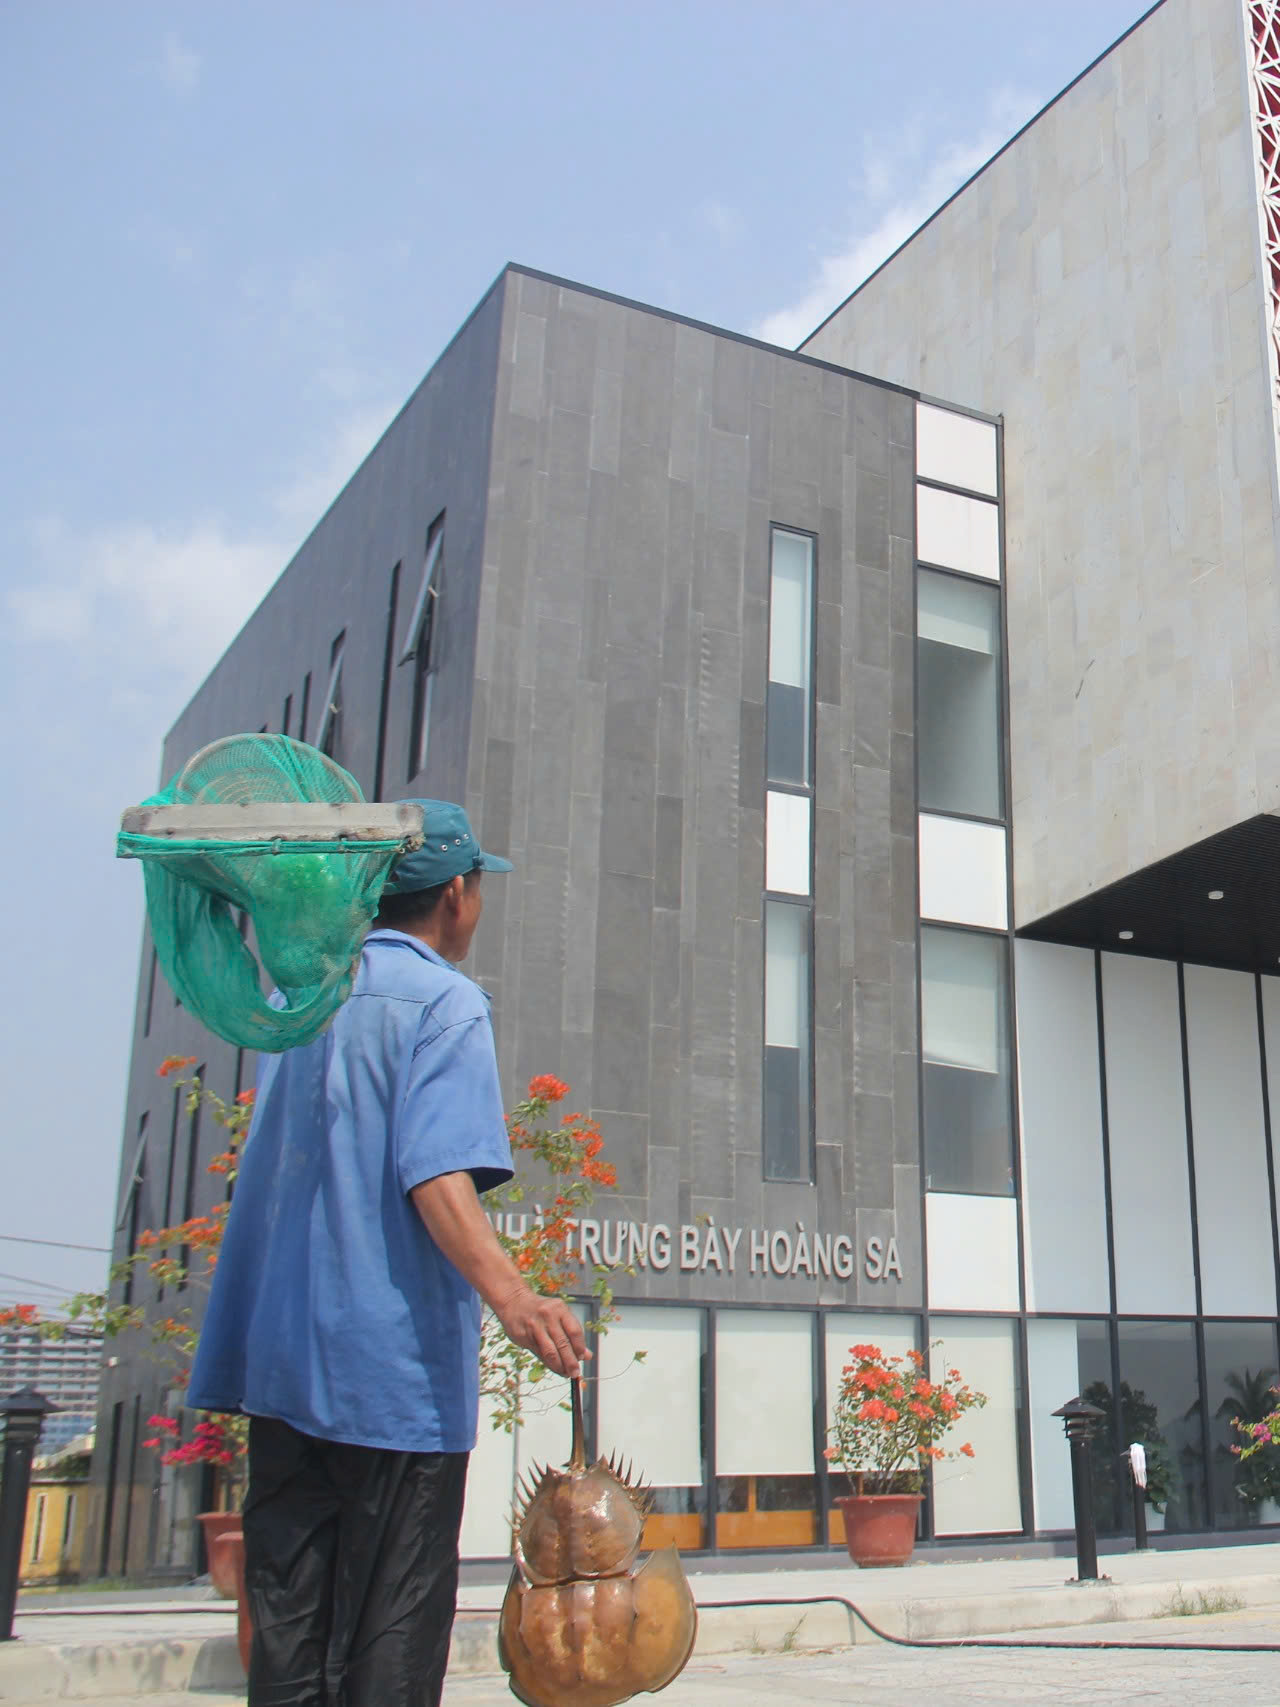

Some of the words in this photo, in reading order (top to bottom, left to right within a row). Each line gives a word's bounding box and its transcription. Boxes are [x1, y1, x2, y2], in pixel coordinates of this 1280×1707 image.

[564, 1217, 671, 1269] TRƯNG
[680, 1216, 742, 1271] BÀY
[750, 1221, 853, 1279] HOÀNG
[865, 1236, 904, 1280] SA
